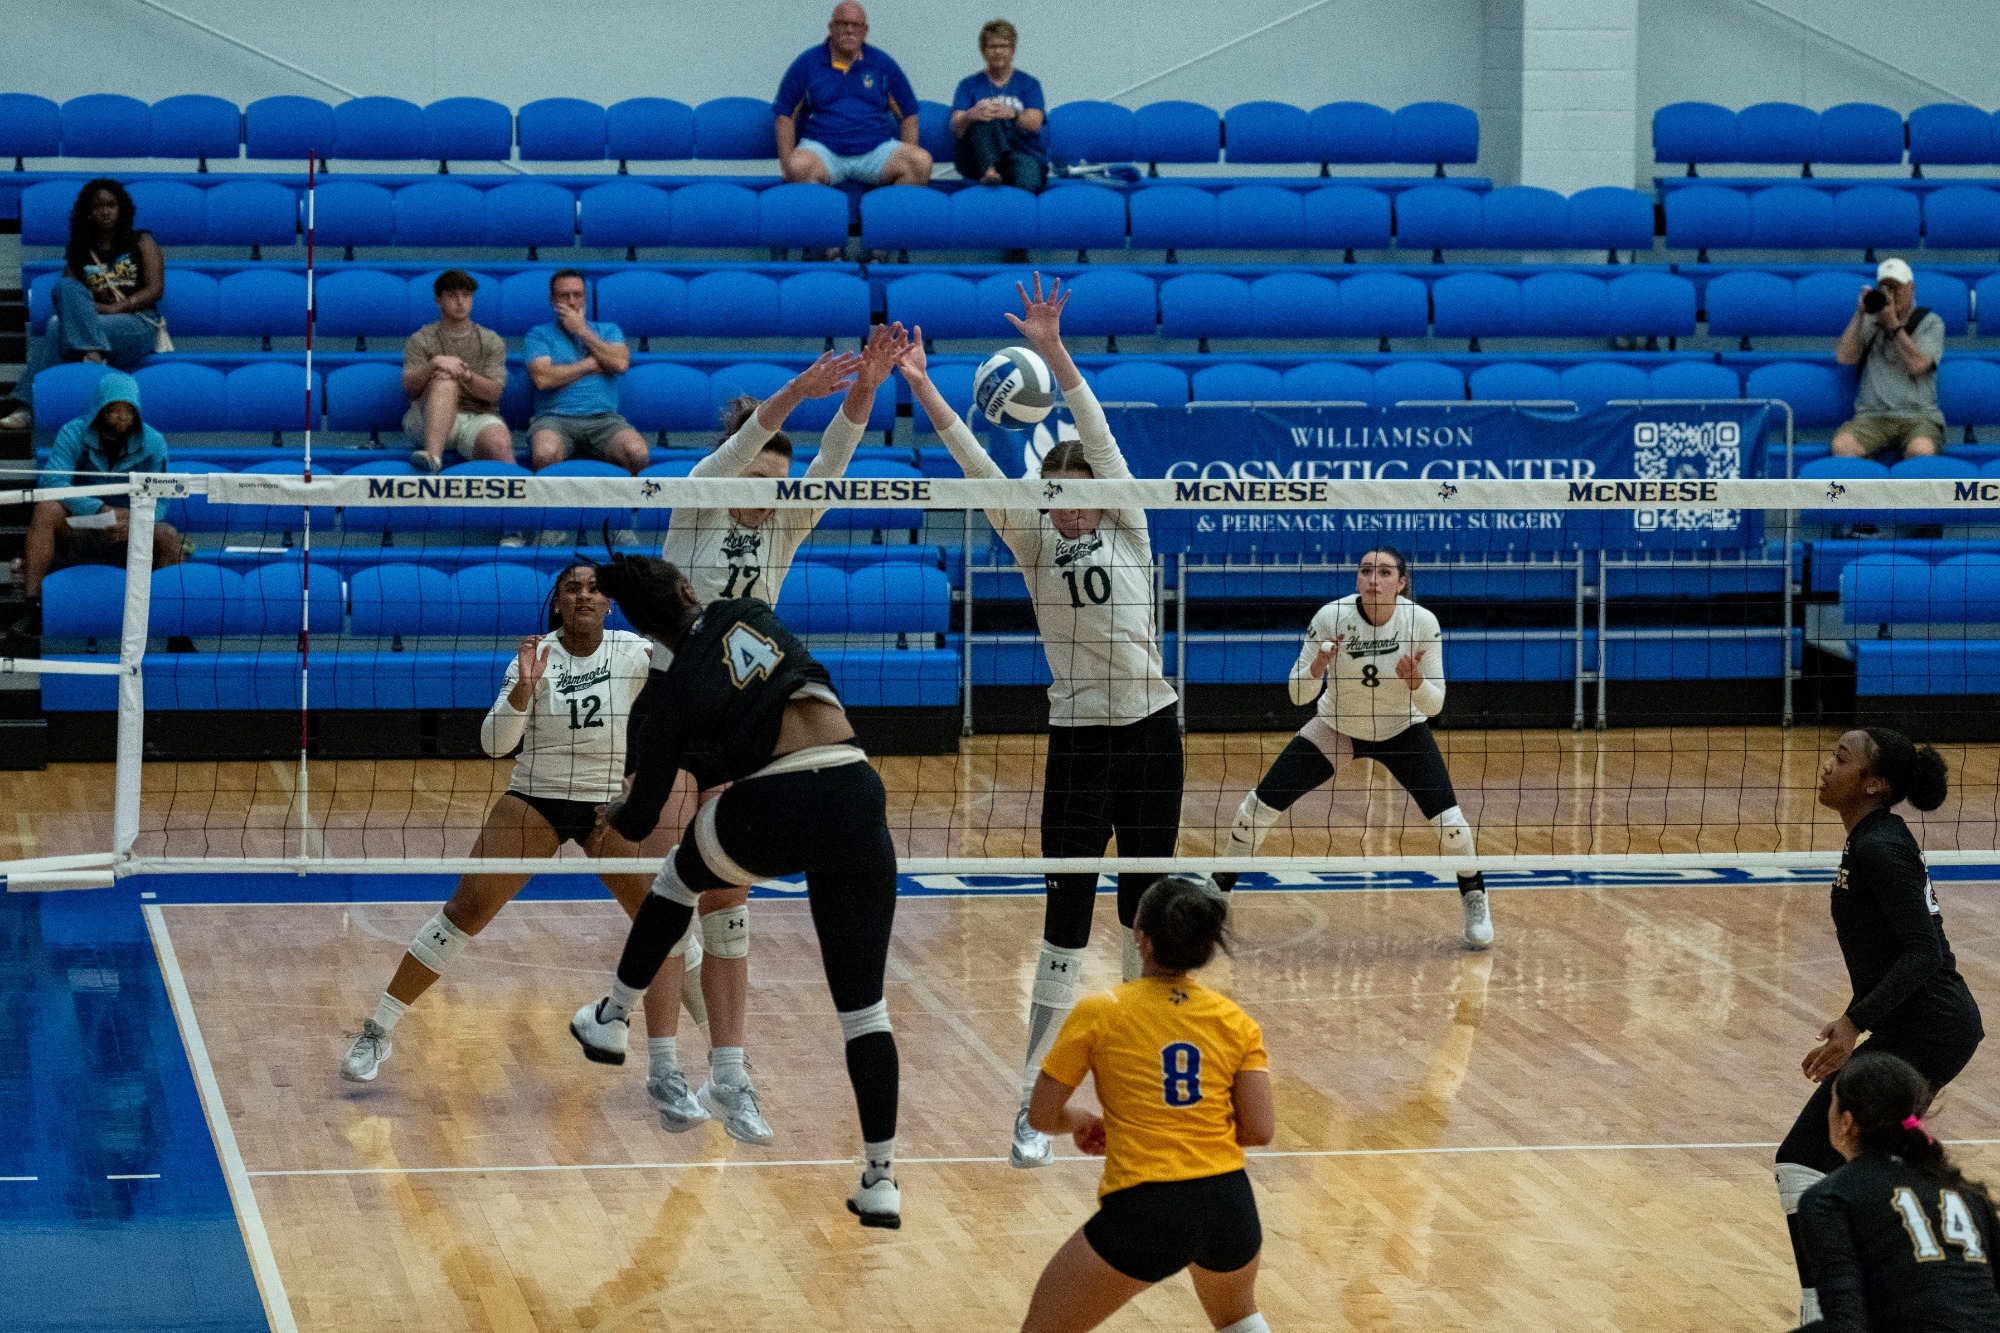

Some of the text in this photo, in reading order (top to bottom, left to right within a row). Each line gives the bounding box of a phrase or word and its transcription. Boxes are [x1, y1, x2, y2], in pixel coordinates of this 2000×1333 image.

[986, 379, 1015, 417] molten
[1291, 426, 1473, 448] WILLIAMSON
[368, 478, 527, 499] McNEESE
[776, 480, 931, 501] McNEESE
[1174, 481, 1328, 502] McNEESE
[1567, 481, 1718, 502] McNEESE
[1953, 481, 2000, 501] Mc
[1196, 511, 1565, 532] & PERENACK AESTHETIC SURGERY
[719, 563, 761, 599] 17
[1062, 566, 1111, 608] 10
[1346, 630, 1399, 651] Hammond
[721, 621, 785, 690] 4
[556, 658, 610, 688] Hammond
[1361, 664, 1380, 688] 8
[565, 694, 604, 730] 12
[1160, 1040, 1204, 1108] 8
[1890, 1187, 1988, 1264] 14
